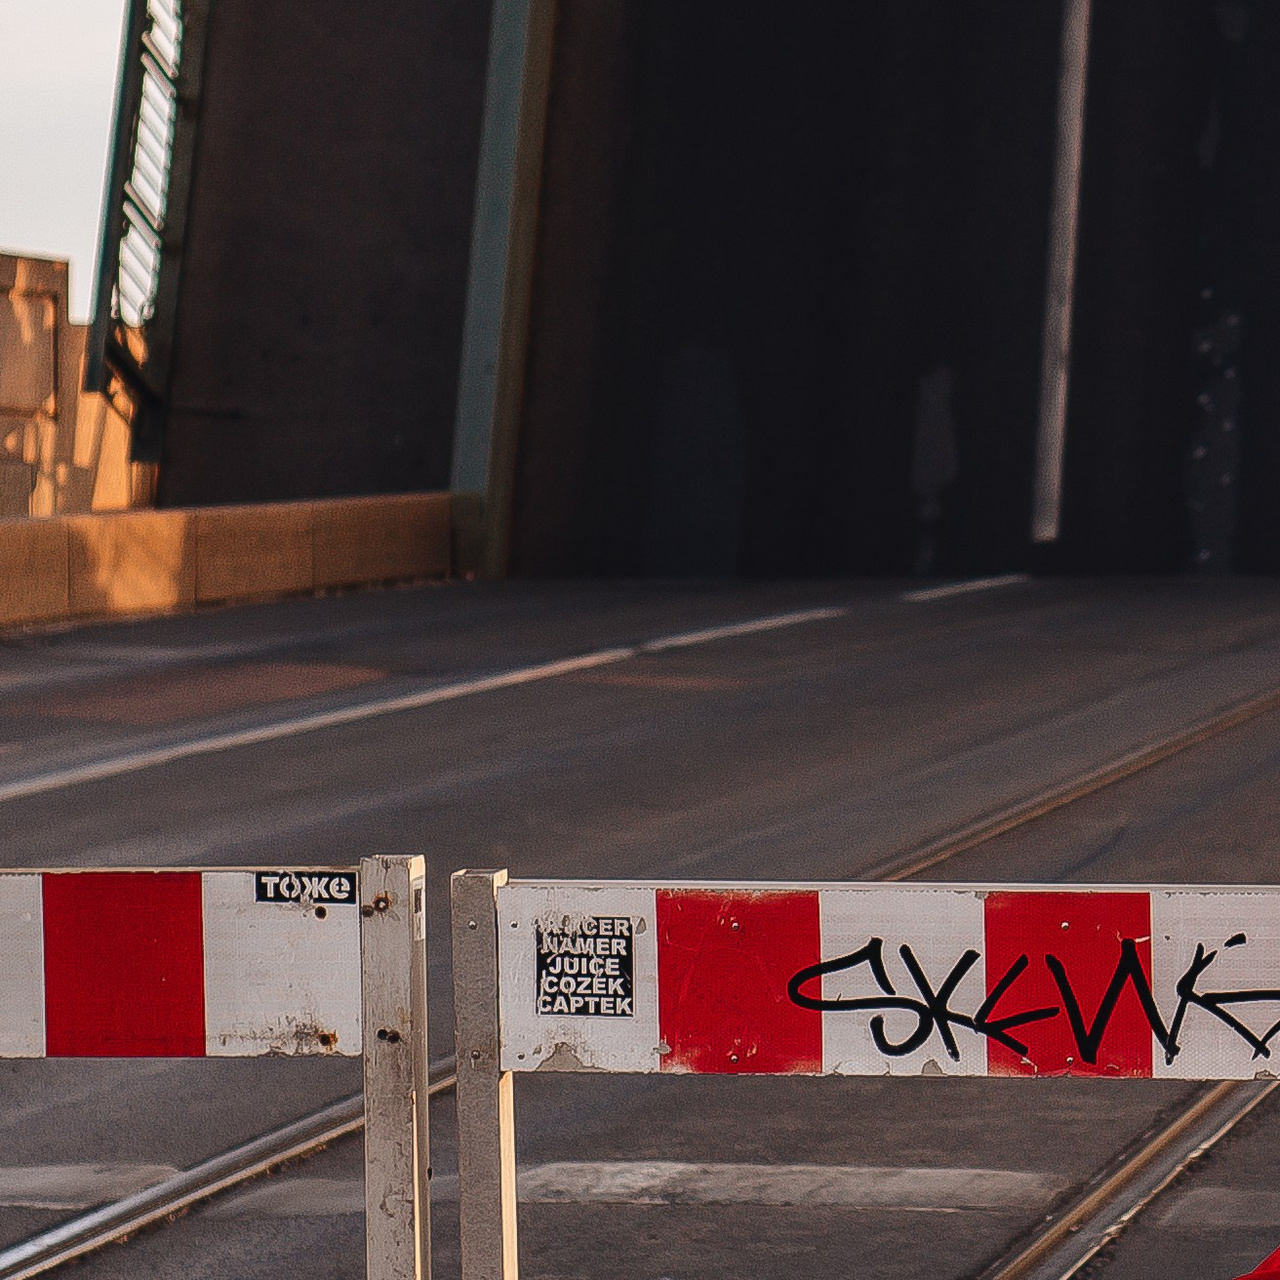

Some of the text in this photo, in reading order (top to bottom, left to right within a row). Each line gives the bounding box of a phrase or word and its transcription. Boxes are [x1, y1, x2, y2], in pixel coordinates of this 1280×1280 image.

[541, 937, 627, 956] NAMER
[548, 956, 621, 976] JUICE
[541, 975, 625, 996] COZEK
[538, 995, 633, 1015] CAPTEK
